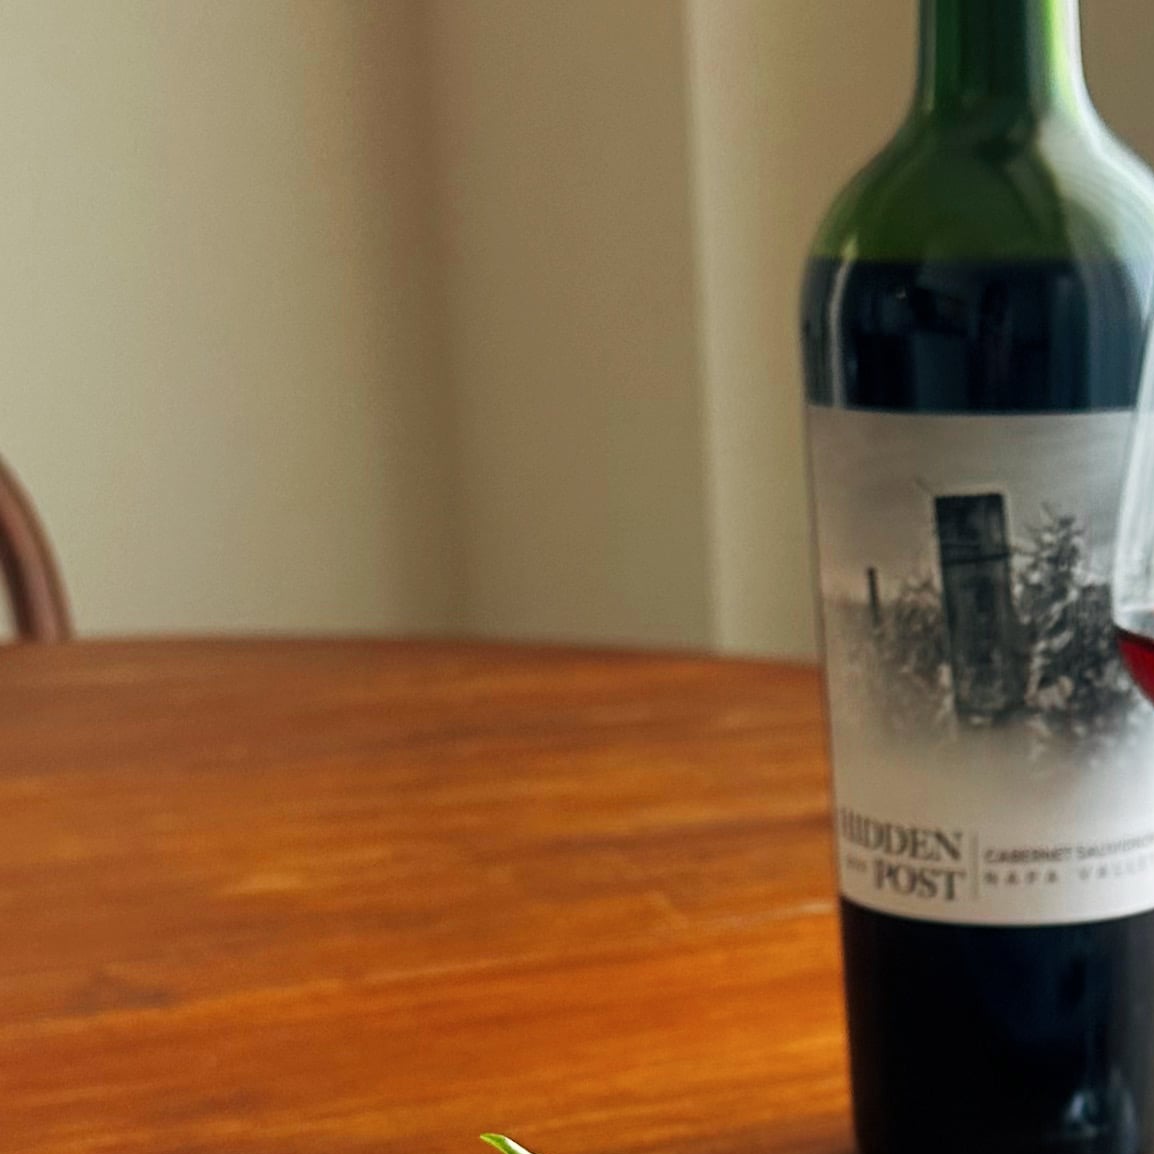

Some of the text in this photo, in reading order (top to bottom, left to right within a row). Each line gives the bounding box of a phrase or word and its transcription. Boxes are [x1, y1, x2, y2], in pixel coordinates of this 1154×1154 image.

[841, 807, 963, 862] HIDDEN
[984, 846, 1072, 863] CABERNET
[874, 857, 967, 902] POST
[984, 869, 1058, 885] NAPA
